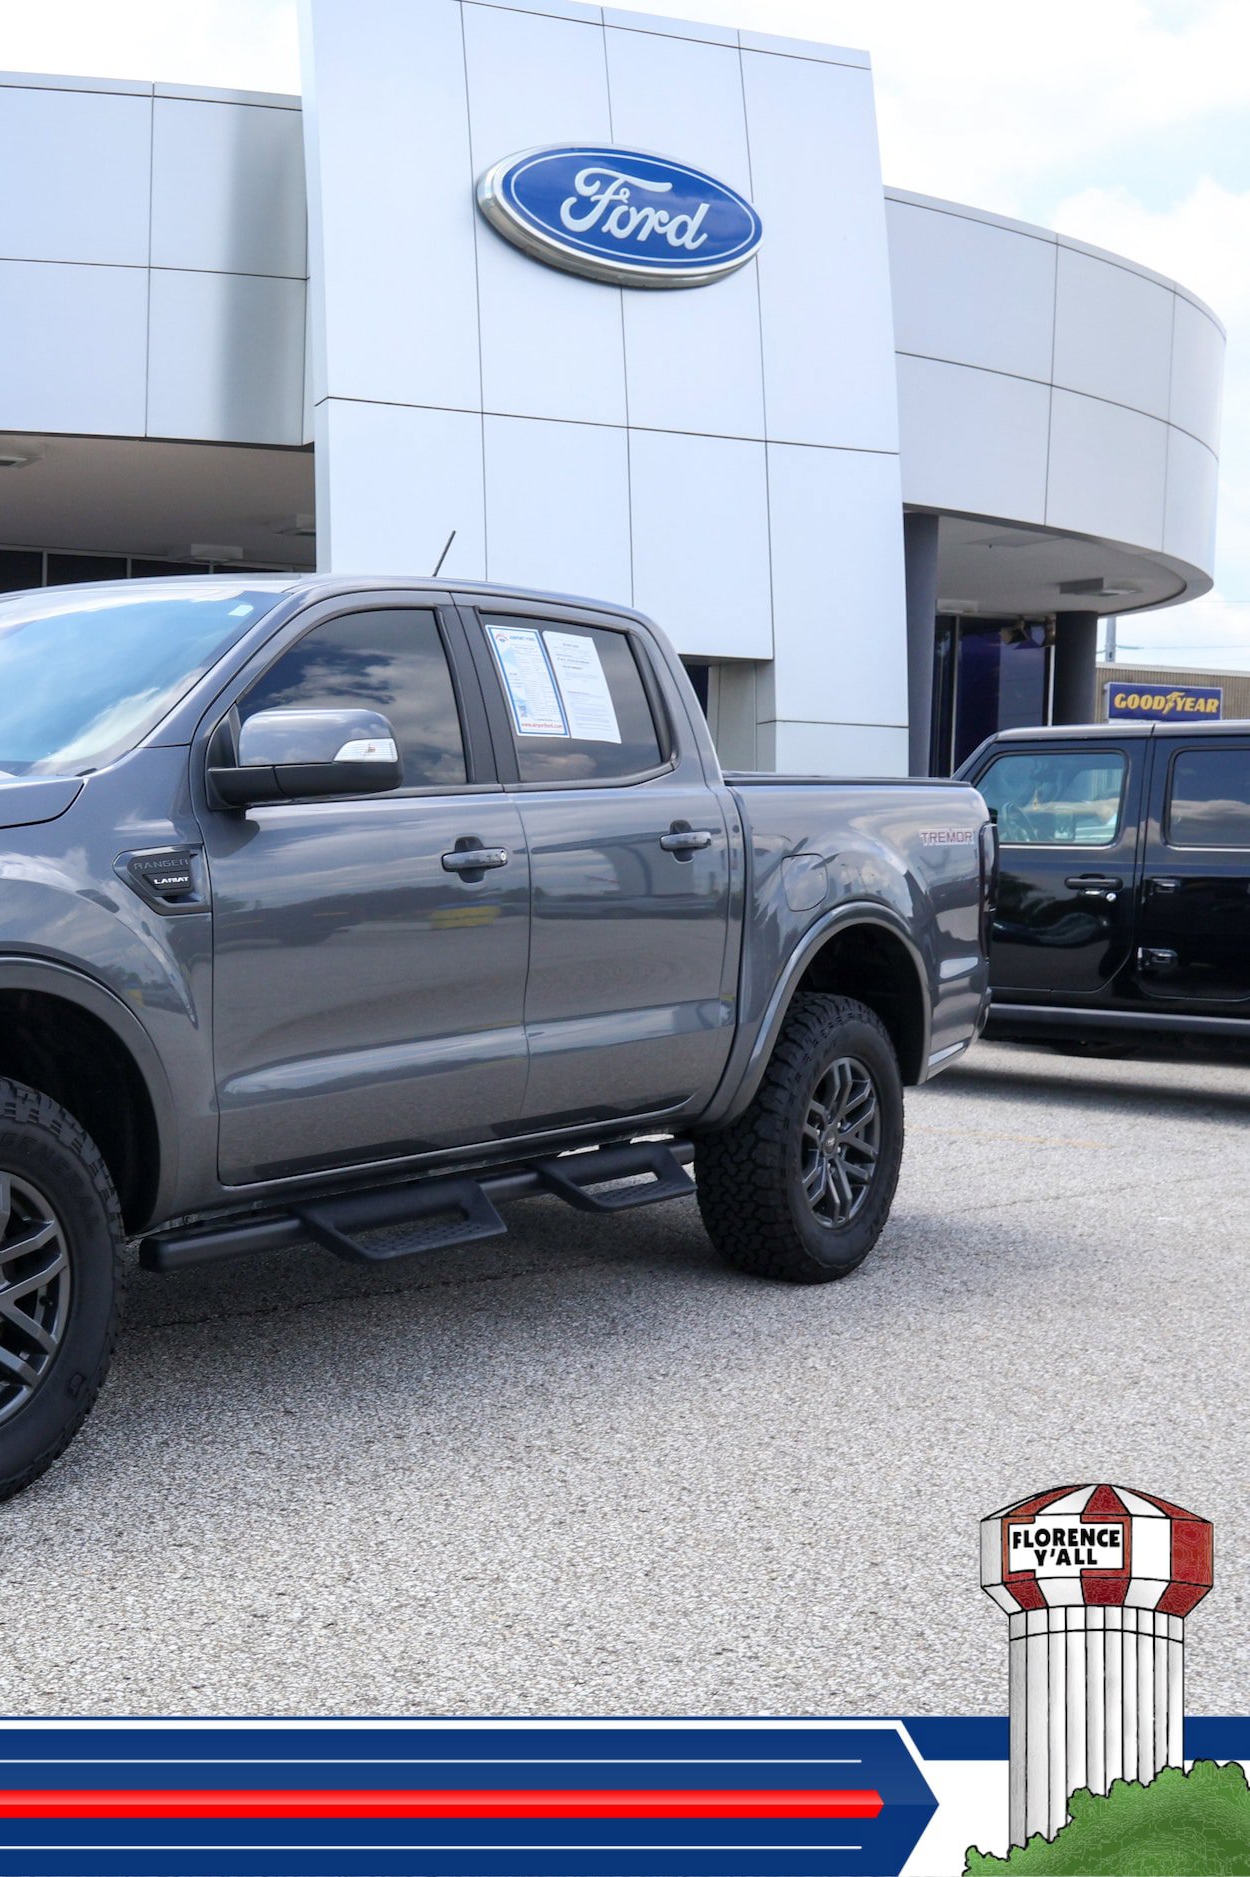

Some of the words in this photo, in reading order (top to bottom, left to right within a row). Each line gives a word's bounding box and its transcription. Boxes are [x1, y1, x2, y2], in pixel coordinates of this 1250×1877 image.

[560, 167, 710, 250] Ford
[1114, 692, 1219, 714] GOODYEAR
[919, 830, 974, 845] TREMOR
[134, 859, 189, 870] RANGER
[153, 876, 189, 885] LARIAT
